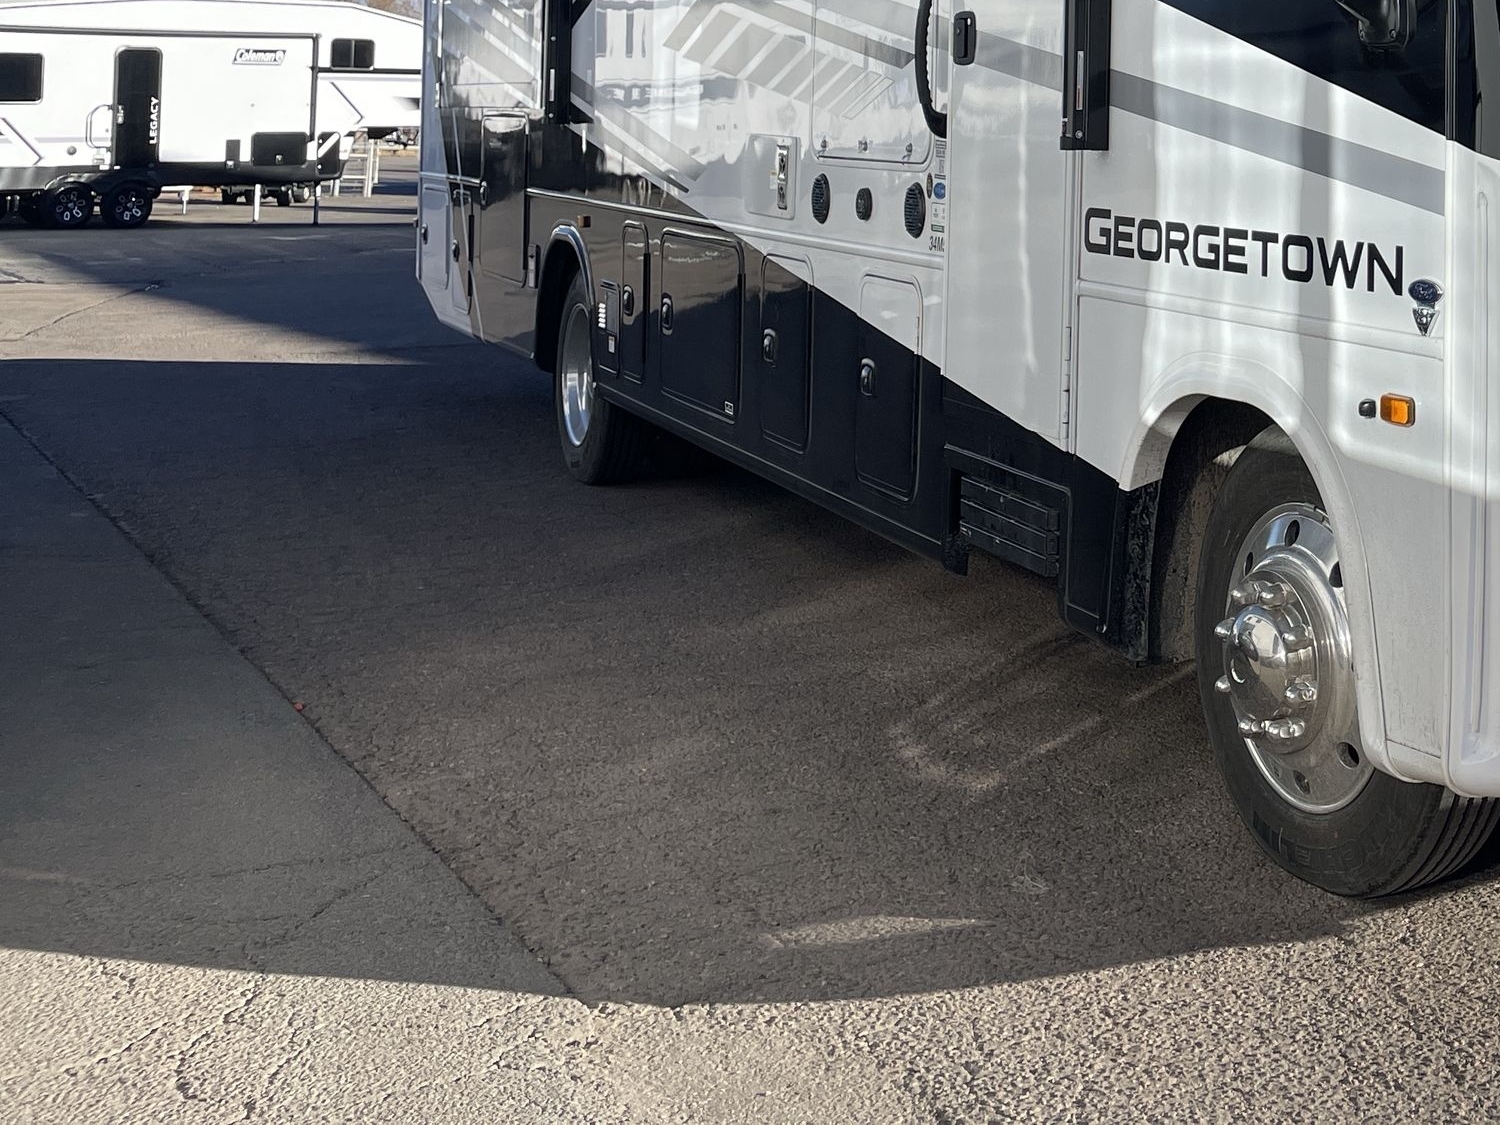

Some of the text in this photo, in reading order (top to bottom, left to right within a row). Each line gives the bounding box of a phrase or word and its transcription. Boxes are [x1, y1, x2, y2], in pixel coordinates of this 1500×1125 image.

[234, 48, 275, 63] Coleman
[149, 97, 159, 144] LEGACY
[1084, 207, 1404, 296] GEORGETOWN
